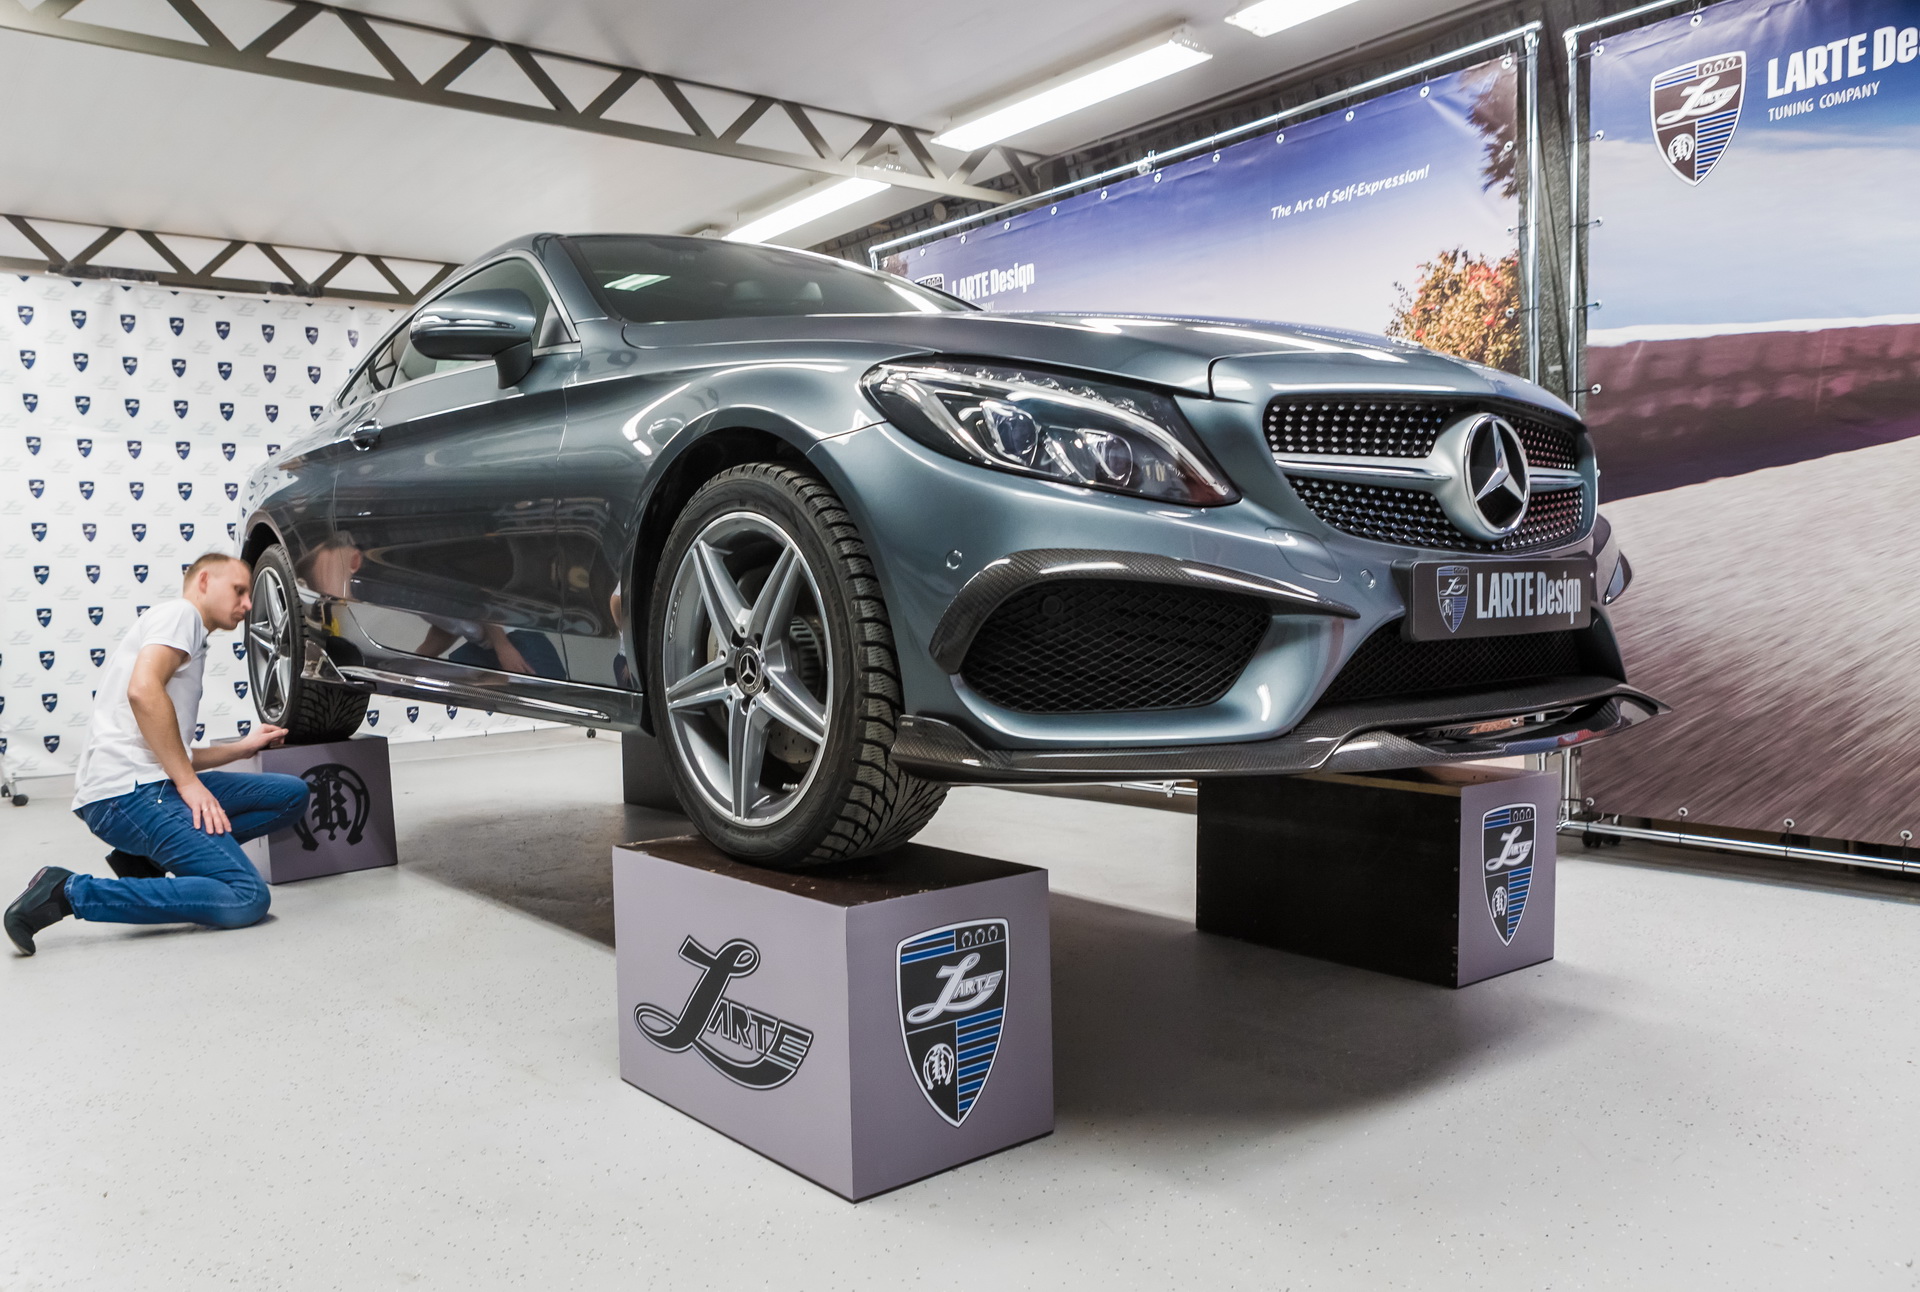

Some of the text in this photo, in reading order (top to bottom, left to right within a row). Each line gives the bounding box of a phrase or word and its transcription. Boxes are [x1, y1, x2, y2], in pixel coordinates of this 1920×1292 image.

[1767, 26, 1920, 99] LARTE De
[1768, 80, 1880, 122] TUNING COMPANY
[1271, 164, 1430, 220] The Art of Self-Expression!
[990, 262, 1035, 293] Design
[1476, 570, 1582, 625] LARTE Design
[634, 934, 814, 1091] LARTE
[906, 952, 1004, 1024] LARTE
